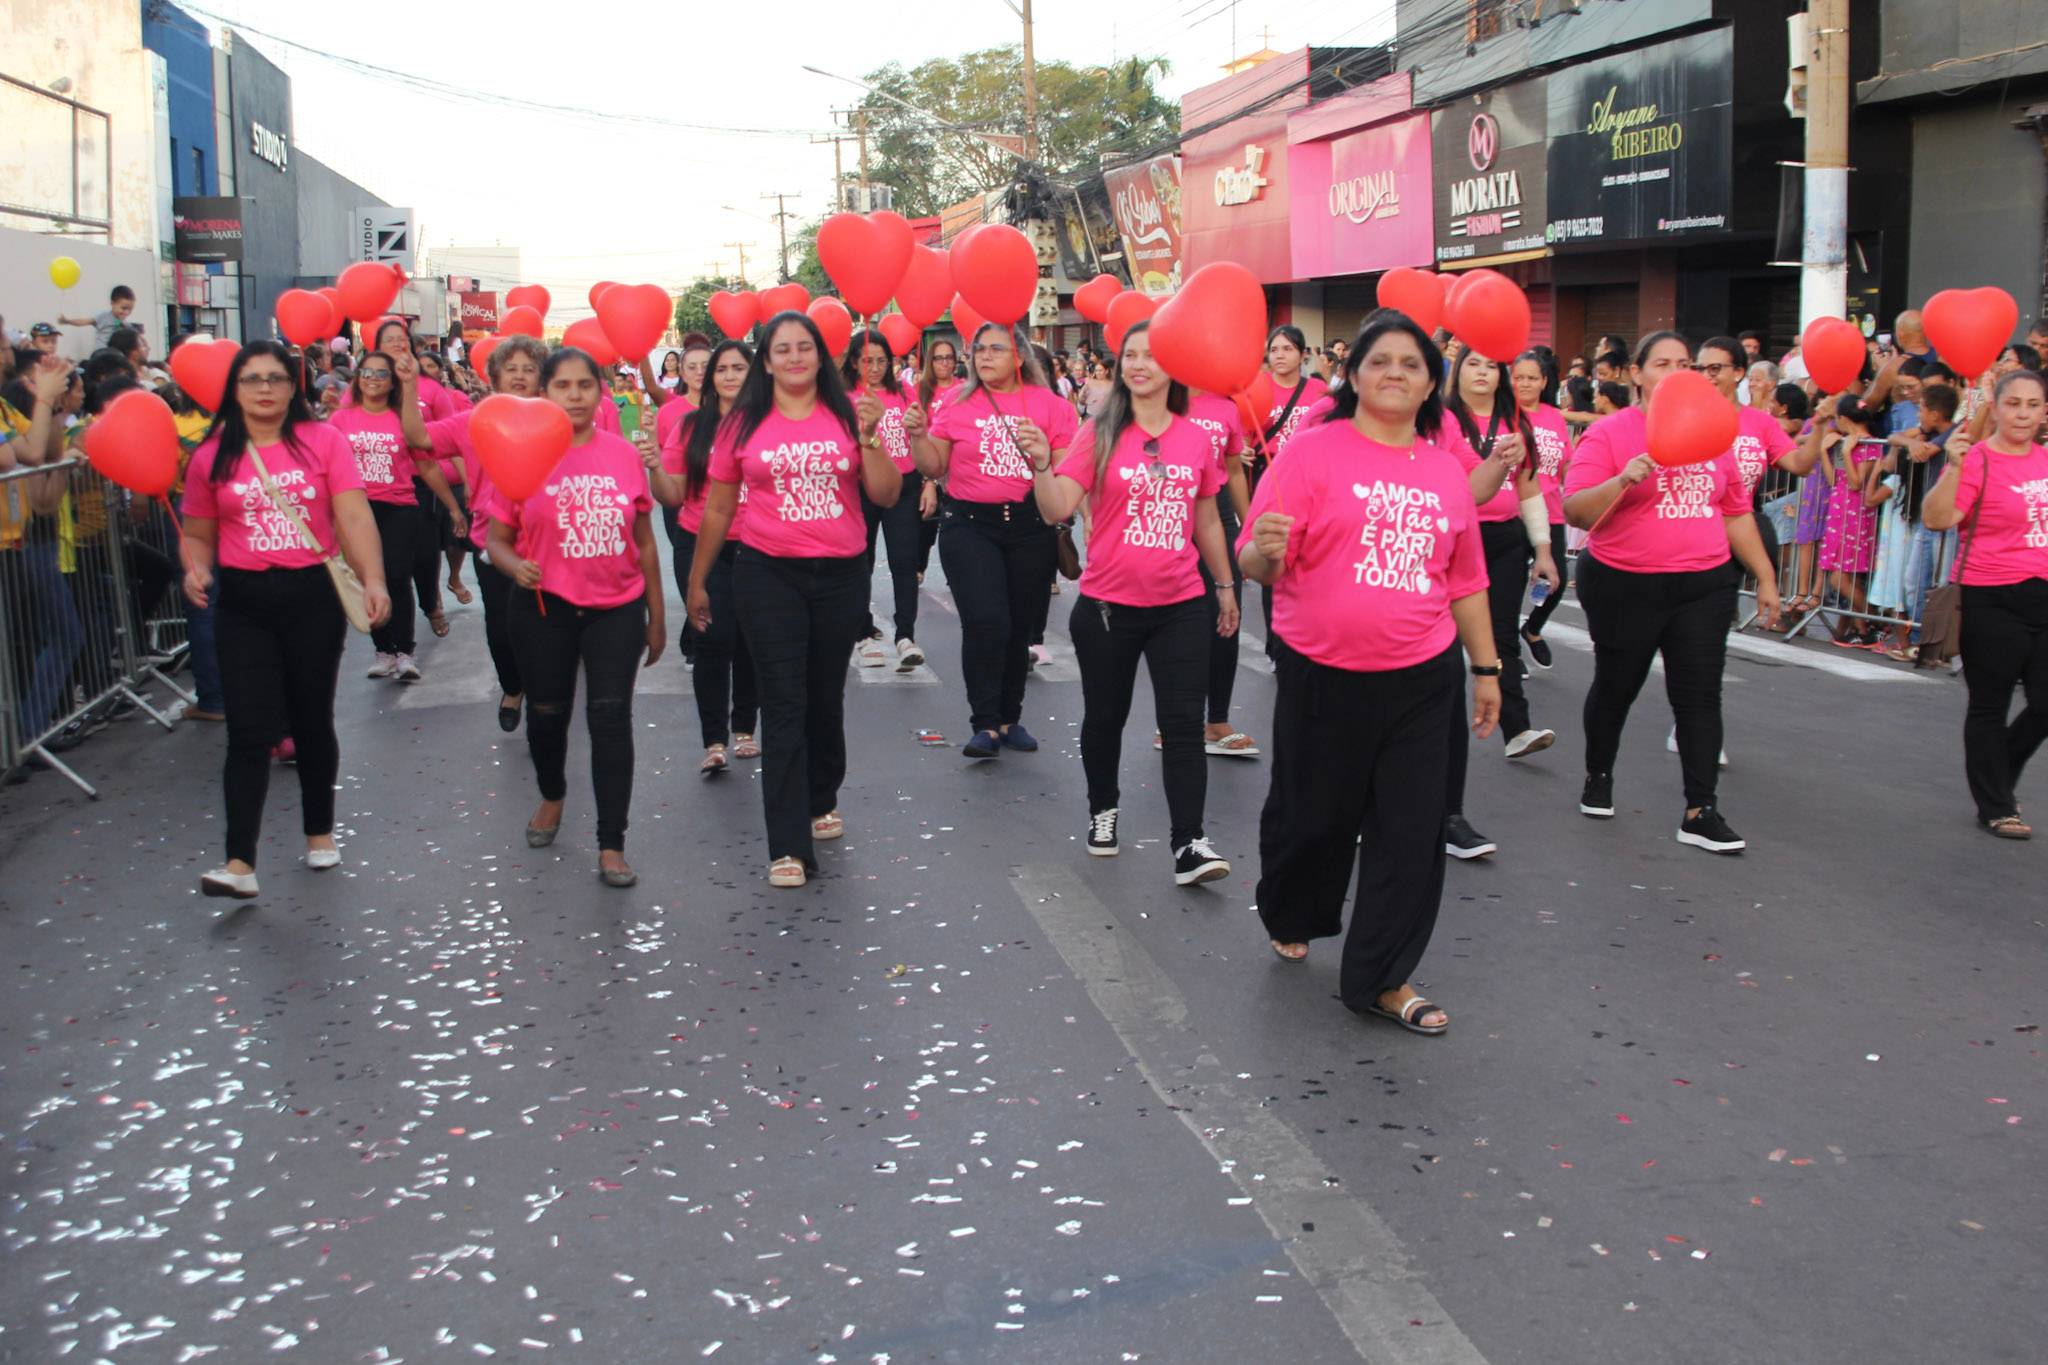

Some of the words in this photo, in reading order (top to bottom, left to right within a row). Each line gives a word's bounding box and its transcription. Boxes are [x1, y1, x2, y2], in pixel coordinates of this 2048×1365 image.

[1587, 86, 1658, 146] Aryane
[252, 121, 281, 168] STUDIO
[1612, 123, 1682, 160] RIBEIRO
[1329, 170, 1399, 217] ORIGINAL
[1451, 170, 1521, 217] MORATA
[189, 219, 240, 232] MORENA
[212, 230, 242, 240] MAKES
[1466, 214, 1503, 237] FASHION
[364, 217, 373, 262] STUDIO
[358, 430, 395, 442] AMOR
[775, 440, 840, 457] AMOR
[364, 453, 393, 466] PARA
[770, 454, 838, 480] Mãe
[984, 453, 994, 464] A
[366, 463, 391, 474] VIDA
[1135, 463, 1194, 481] AOR
[560, 474, 618, 490] AMOR
[774, 475, 786, 495] É
[791, 478, 840, 494] PARA
[1129, 475, 1187, 505] Mãe
[1131, 477, 1143, 485] DE
[1657, 473, 1669, 492] É
[1672, 476, 1715, 491] PARA
[556, 487, 620, 513] Mãe
[783, 493, 796, 507] A
[797, 490, 837, 506] VIDA
[1368, 496, 1381, 506] DE
[1371, 480, 1442, 511] AMOR
[1662, 491, 1674, 505] A
[777, 505, 830, 522] TODA!
[1126, 496, 1140, 516] É
[1143, 501, 1188, 521] PARA
[1366, 497, 1434, 535] Mãe
[557, 508, 571, 529] É
[575, 511, 625, 528] PARA
[1129, 516, 1142, 530] A
[1146, 517, 1183, 535] VIDA
[253, 525, 266, 537] A
[268, 521, 301, 536] VID
[566, 529, 578, 543] A
[582, 526, 623, 542] VIDA
[248, 535, 301, 552] TODA!
[1123, 530, 1174, 550] TODA!
[1360, 521, 1378, 547] É
[1381, 529, 1435, 559] PARA
[560, 541, 613, 559] TODA!
[1363, 547, 1379, 567] A
[1385, 550, 1428, 576] VIDA
[1353, 562, 1416, 592] TODA!
